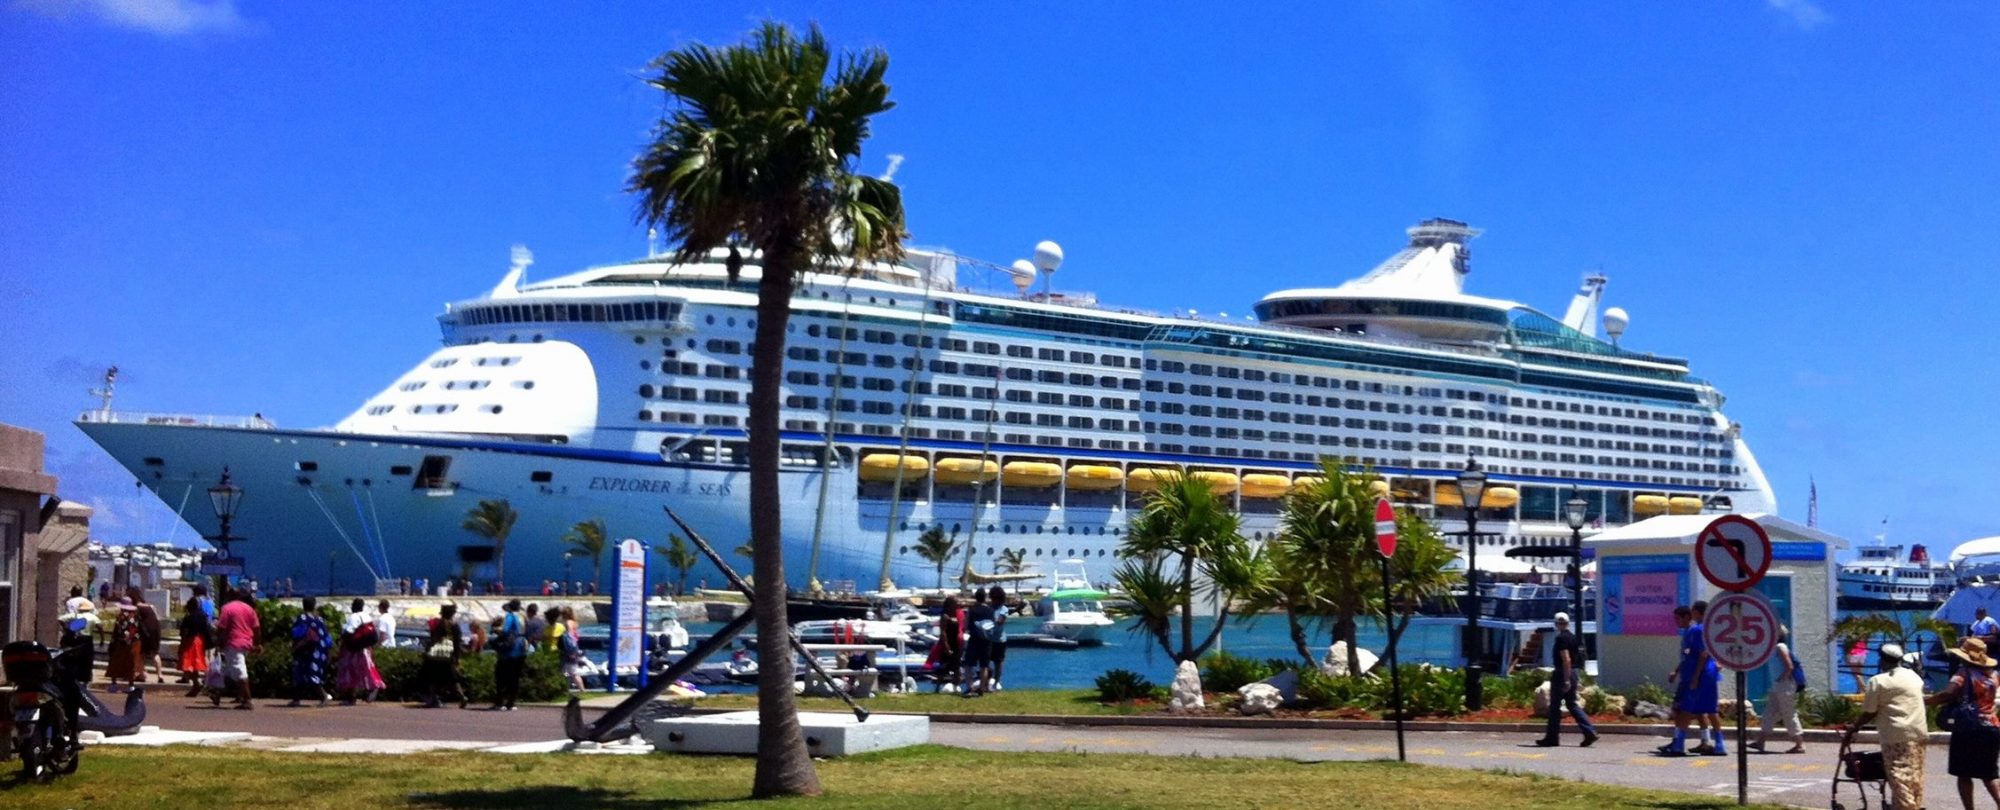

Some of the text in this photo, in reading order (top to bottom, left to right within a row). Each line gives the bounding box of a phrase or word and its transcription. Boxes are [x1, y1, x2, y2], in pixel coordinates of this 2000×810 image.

[588, 476, 670, 493] EXPLORER
[699, 482, 732, 496] SEAS
[1625, 596, 1674, 605] INFORMATION
[1714, 614, 1765, 645] 25
